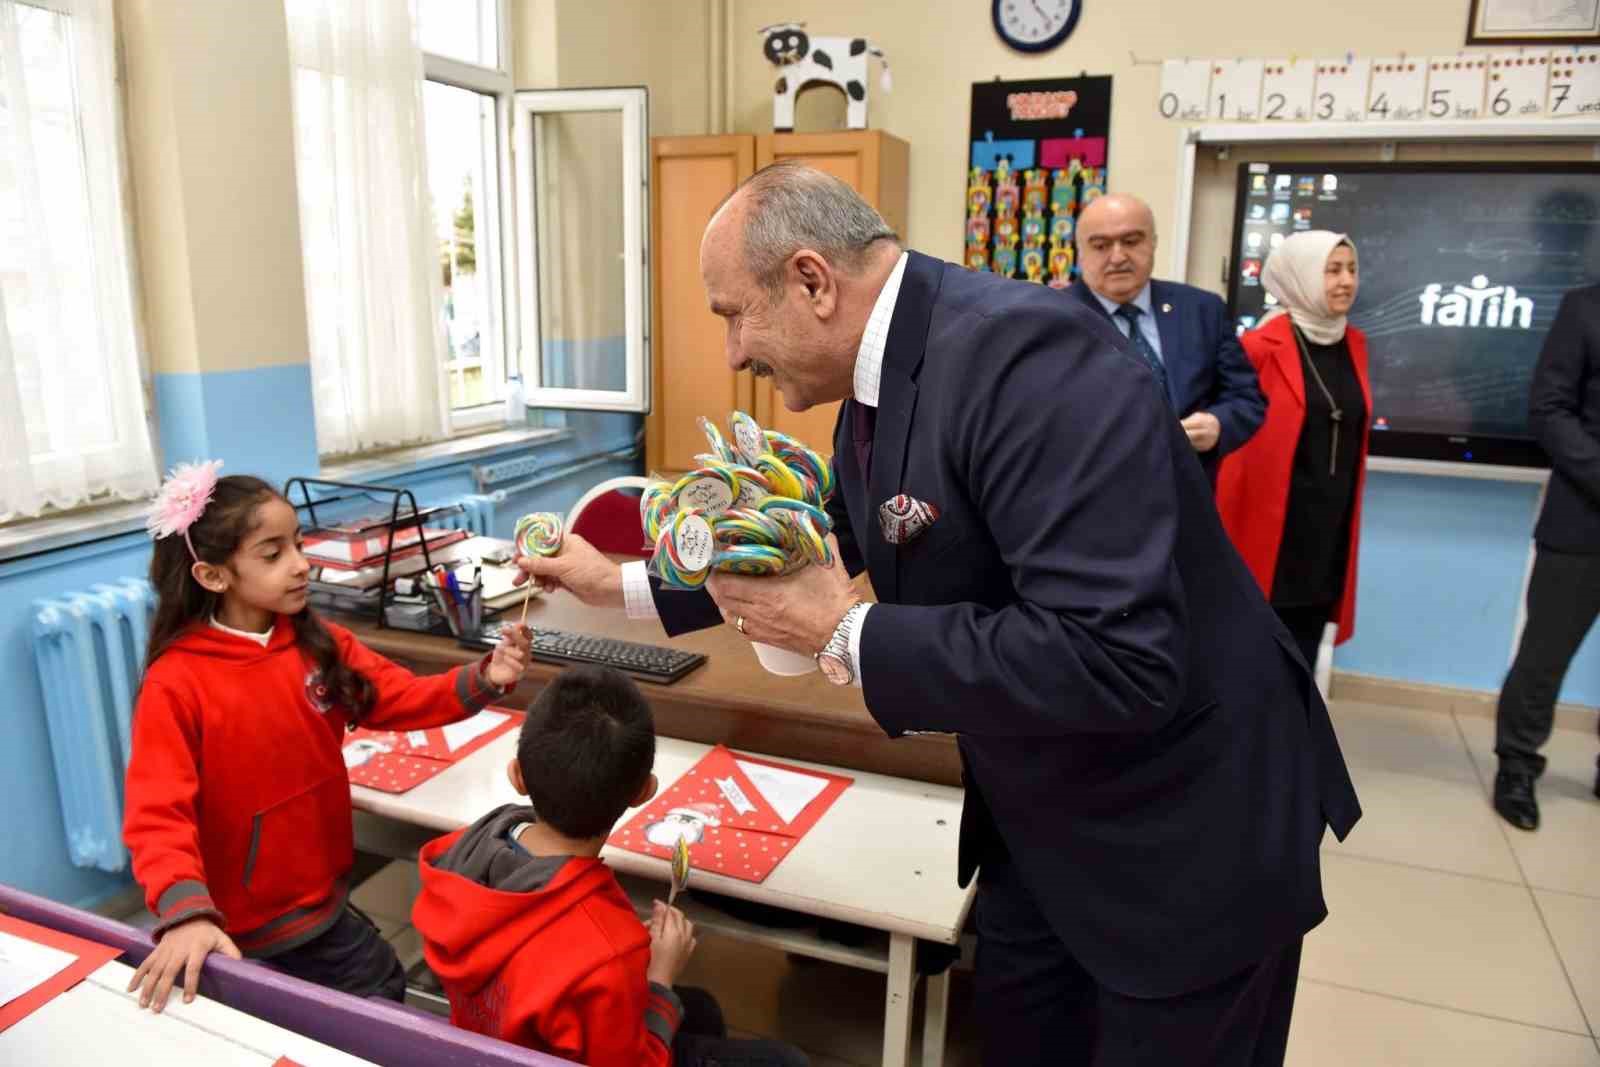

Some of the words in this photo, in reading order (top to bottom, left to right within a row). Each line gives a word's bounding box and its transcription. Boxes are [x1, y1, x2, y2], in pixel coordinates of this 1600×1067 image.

[1159, 92, 1179, 119] 0
[1218, 93, 1226, 119] 1
[1265, 93, 1286, 120] 2
[1317, 92, 1335, 120] 3
[1369, 91, 1391, 118] 4
[1429, 89, 1452, 117] 5
[1492, 88, 1511, 116] 6
[1551, 84, 1571, 113] 7
